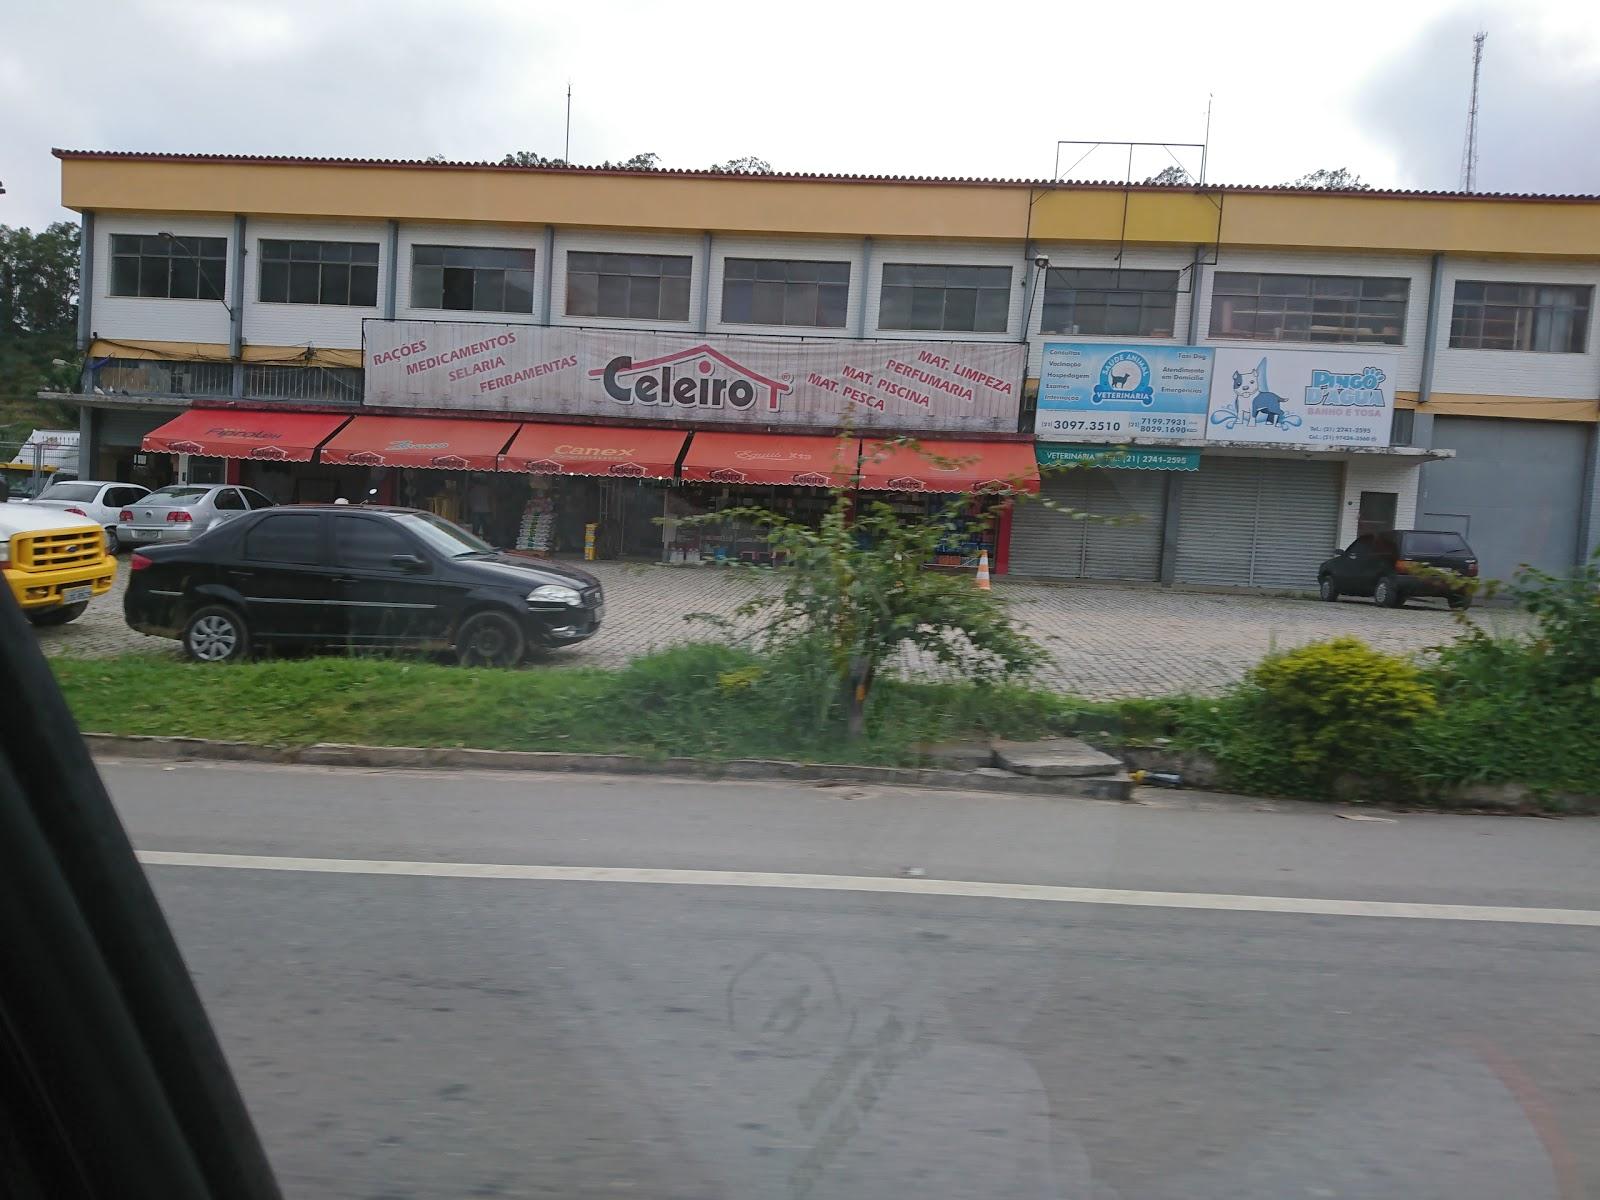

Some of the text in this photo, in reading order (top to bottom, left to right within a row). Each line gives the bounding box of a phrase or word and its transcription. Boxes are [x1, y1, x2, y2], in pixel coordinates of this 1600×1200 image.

[373, 340, 427, 365] RAÇÕES
[406, 332, 516, 375] MEDICAMENTOS
[448, 356, 505, 382] SELARIA
[479, 355, 578, 393] FERRAMENTAS
[603, 356, 754, 407] Celeiro
[885, 359, 973, 400] PERFUMARIA
[918, 351, 1012, 394] MAT. LIMPEZA
[1313, 370, 1379, 390] PINGO
[808, 373, 885, 411] MAT. PESCA
[842, 365, 930, 407] MAT. PISCINA
[1141, 417, 1186, 426] 7199.7931
[1307, 407, 1343, 416] BANHO
[1354, 409, 1381, 417] TOSA
[1054, 420, 1121, 431] 3097.3510
[1140, 425, 1186, 433] 8029.1690
[554, 444, 636, 457] Canex
[609, 465, 641, 475] Celeiro
